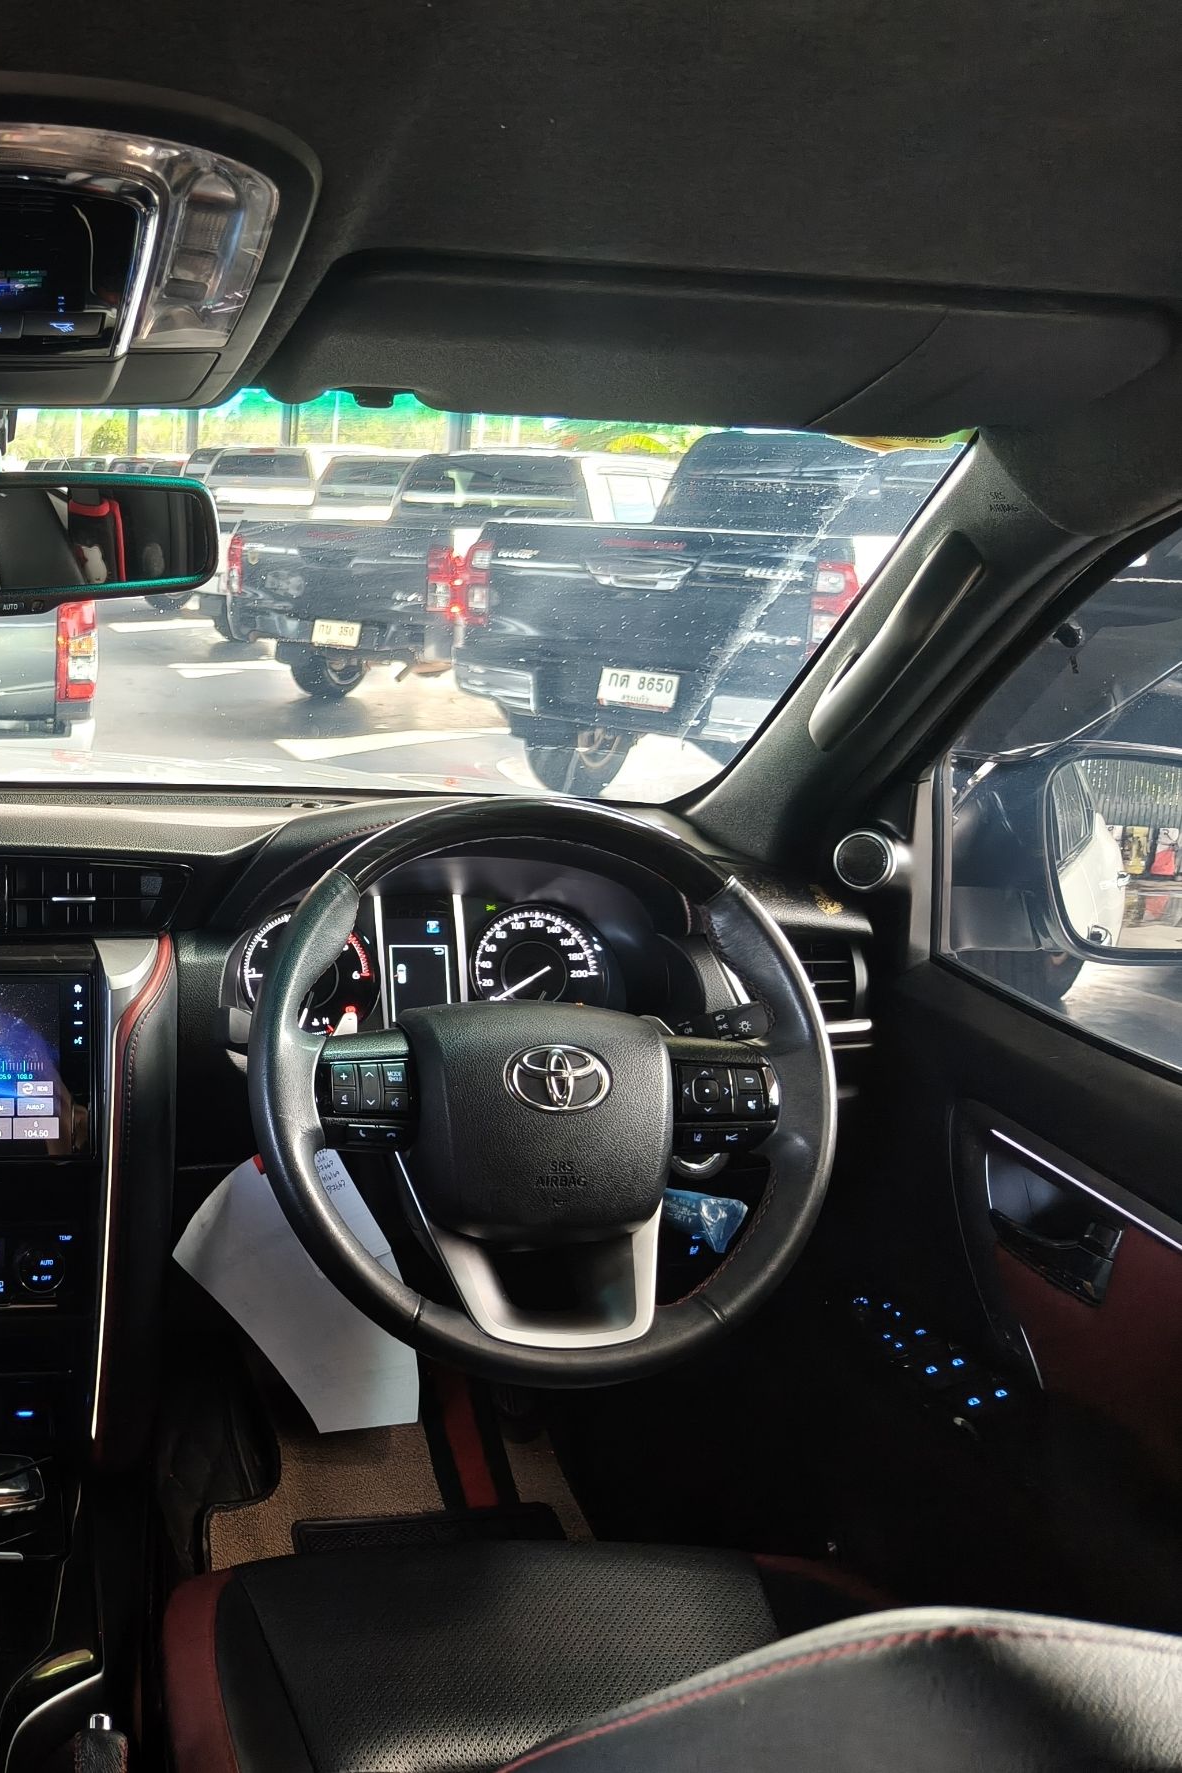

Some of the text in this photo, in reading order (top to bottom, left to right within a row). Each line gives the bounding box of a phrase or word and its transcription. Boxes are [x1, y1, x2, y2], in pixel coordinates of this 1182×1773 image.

[638, 676, 674, 694] 8650
[511, 922, 526, 930] 100
[528, 920, 544, 928] 120
[546, 926, 562, 934] 140
[495, 931, 507, 939] 80
[261, 939, 268, 949] 2
[559, 938, 576, 946] 160
[485, 944, 497, 952] 60
[567, 952, 584, 961] 180
[480, 961, 493, 969] 40
[352, 970, 361, 980] 6
[570, 970, 588, 978] 200
[482, 978, 495, 987] 20
[322, 1017, 330, 1025] H
[24, 1129, 49, 1138] 104.50
[549, 1161, 573, 1172] SRS
[535, 1175, 587, 1187] AIRBAG
